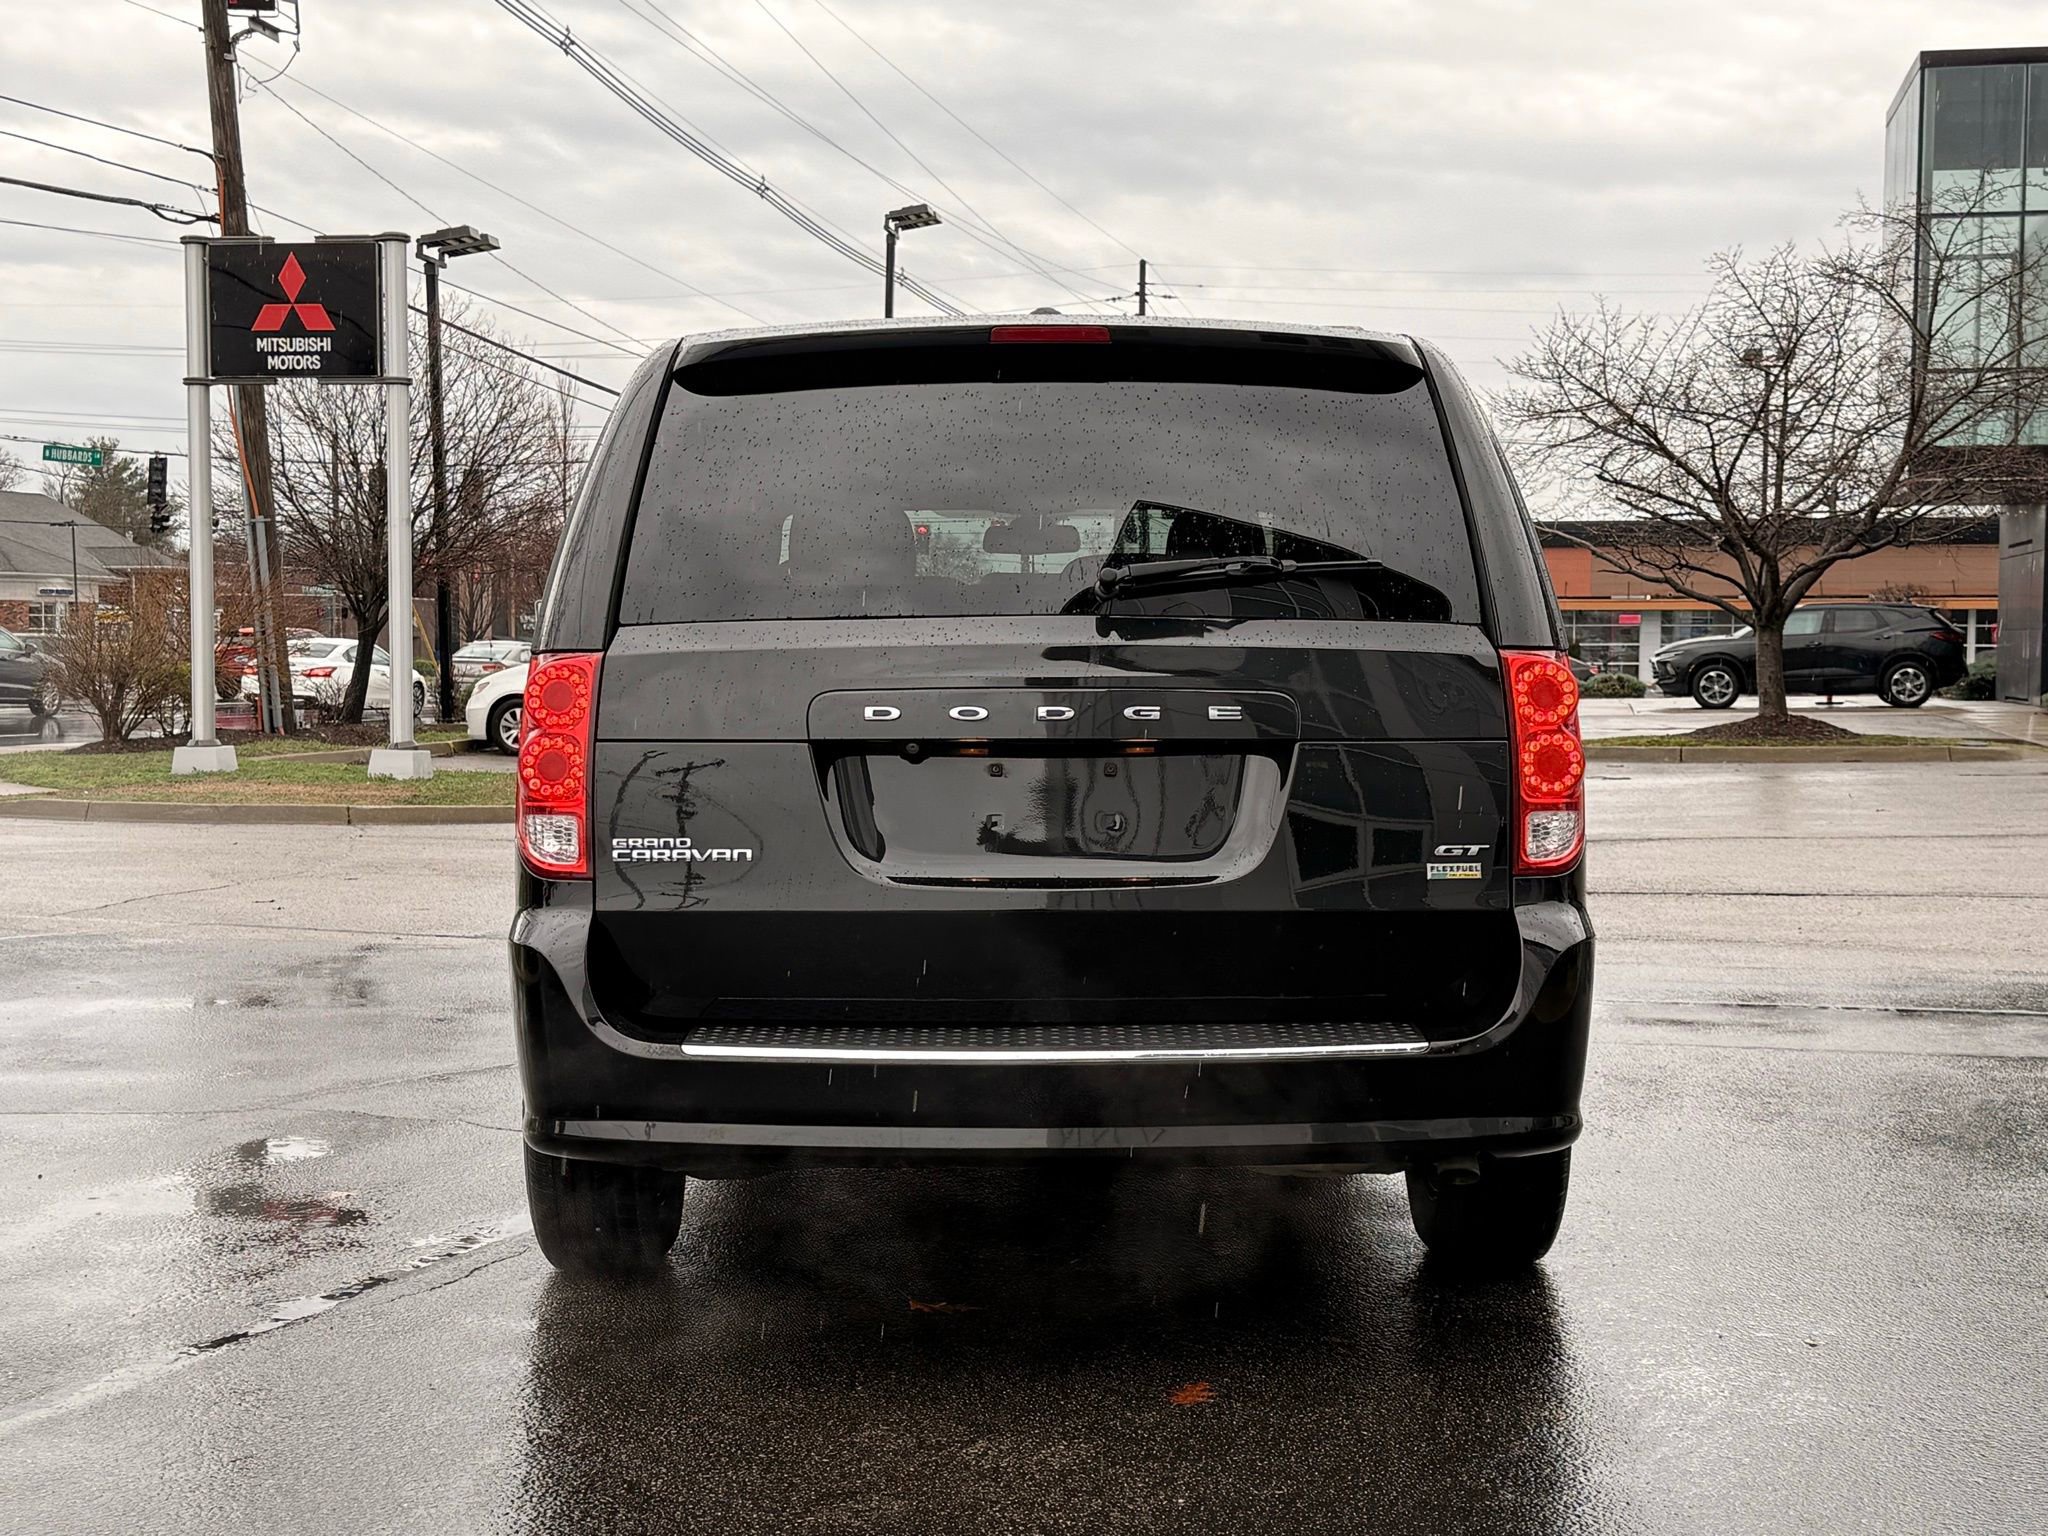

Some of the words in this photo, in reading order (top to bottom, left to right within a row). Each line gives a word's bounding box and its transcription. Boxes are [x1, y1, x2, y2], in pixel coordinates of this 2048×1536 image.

[256, 337, 332, 352] MITSUBISHI
[267, 355, 321, 370] MOTORS
[51, 448, 92, 463] HUBBARDS
[864, 705, 1243, 721] DODGE
[612, 838, 691, 848] GRAND
[612, 849, 752, 861] CARAVAN
[1434, 845, 1490, 855] GT
[1430, 865, 1480, 873] FLEXFUEL
